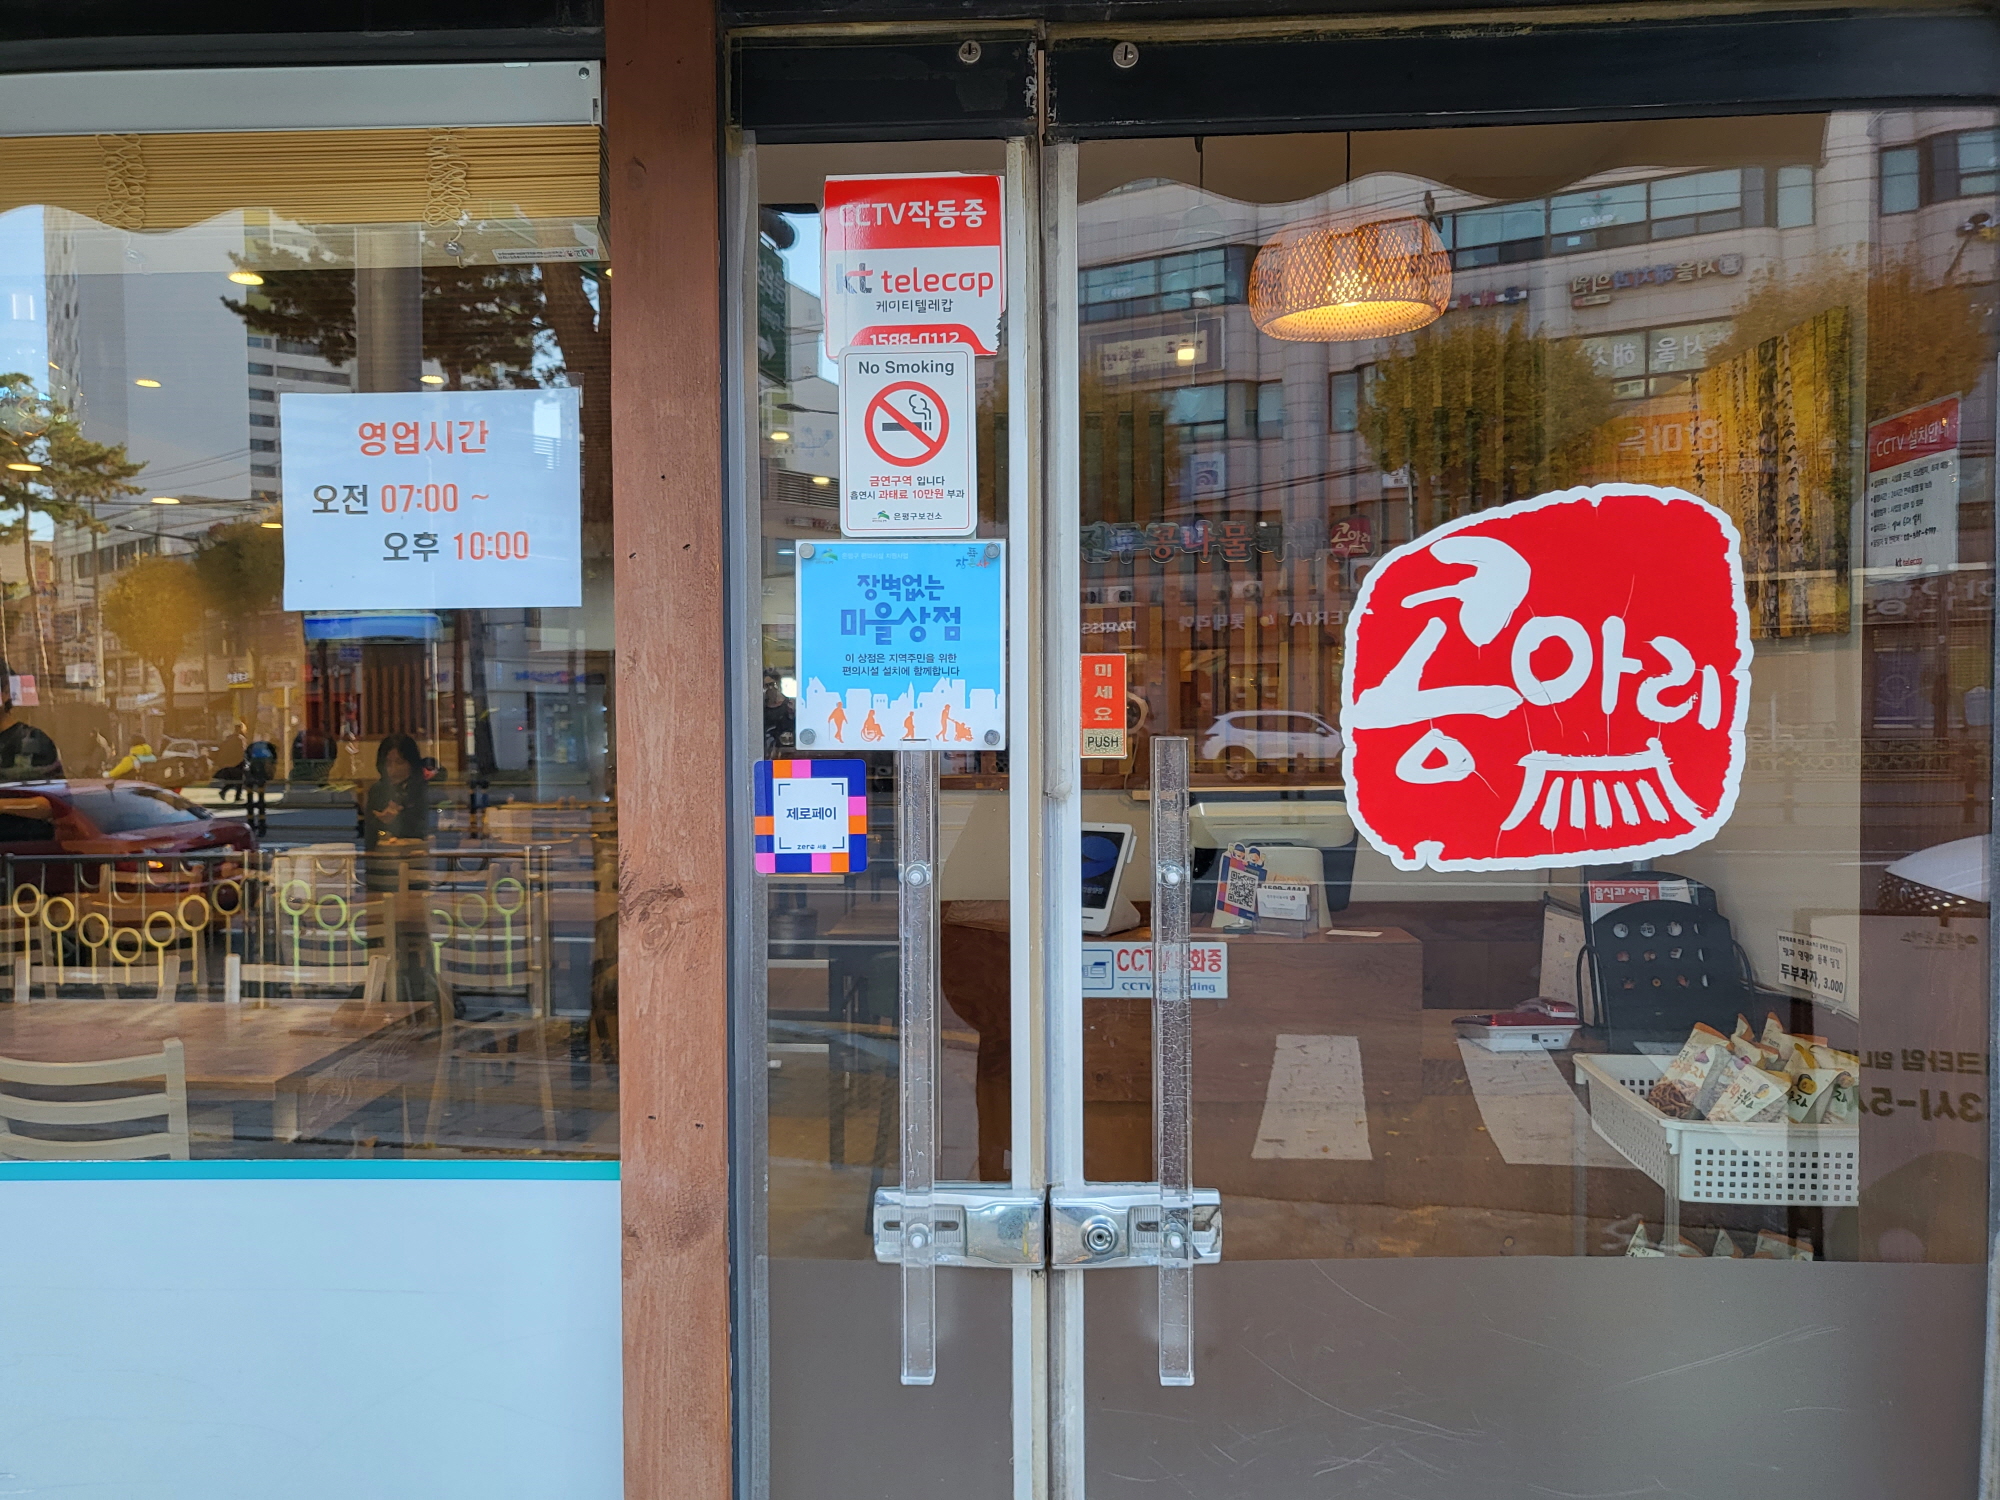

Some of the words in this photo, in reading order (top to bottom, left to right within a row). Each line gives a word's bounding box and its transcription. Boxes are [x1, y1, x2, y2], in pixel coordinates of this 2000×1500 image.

[839, 199, 988, 229] CCTV작동중
[836, 263, 873, 295] kt
[881, 267, 994, 298] telecop
[876, 299, 953, 314] 케이티텔레캅
[870, 332, 960, 346] 1588-0112
[858, 360, 880, 375] No
[885, 359, 955, 376] Smoking
[357, 420, 490, 457] 영업시간
[1876, 434, 1905, 458] CCTV
[1907, 419, 1950, 450] 설치안내
[869, 475, 912, 487] 금연구역
[916, 475, 945, 486] 입니다
[312, 484, 368, 515] 오전
[380, 483, 459, 513] 07:00
[850, 490, 875, 501] 흡연시
[878, 489, 908, 500] 과태료
[912, 488, 944, 500] 10만원
[946, 489, 965, 499] 부과
[893, 512, 943, 521] 은평구보건소
[382, 531, 440, 563] 오후
[453, 530, 530, 561] 10:00
[857, 574, 944, 601] 장벽없는
[840, 602, 961, 645] 마을상점
[845, 653, 854, 663] 이
[857, 653, 885, 663] 상점은
[889, 653, 935, 663] 지역주민을
[938, 653, 957, 663] 위한
[842, 666, 879, 676] 편의시설
[882, 666, 910, 676] 설치에
[913, 666, 960, 676] 함께합니다
[1093, 663, 1113, 721] 미세요
[1087, 736, 1119, 748] PUSH
[786, 807, 837, 820] 제로페이
[1780, 963, 1821, 989] 두부과자,
[1823, 977, 1844, 994] 3.000
